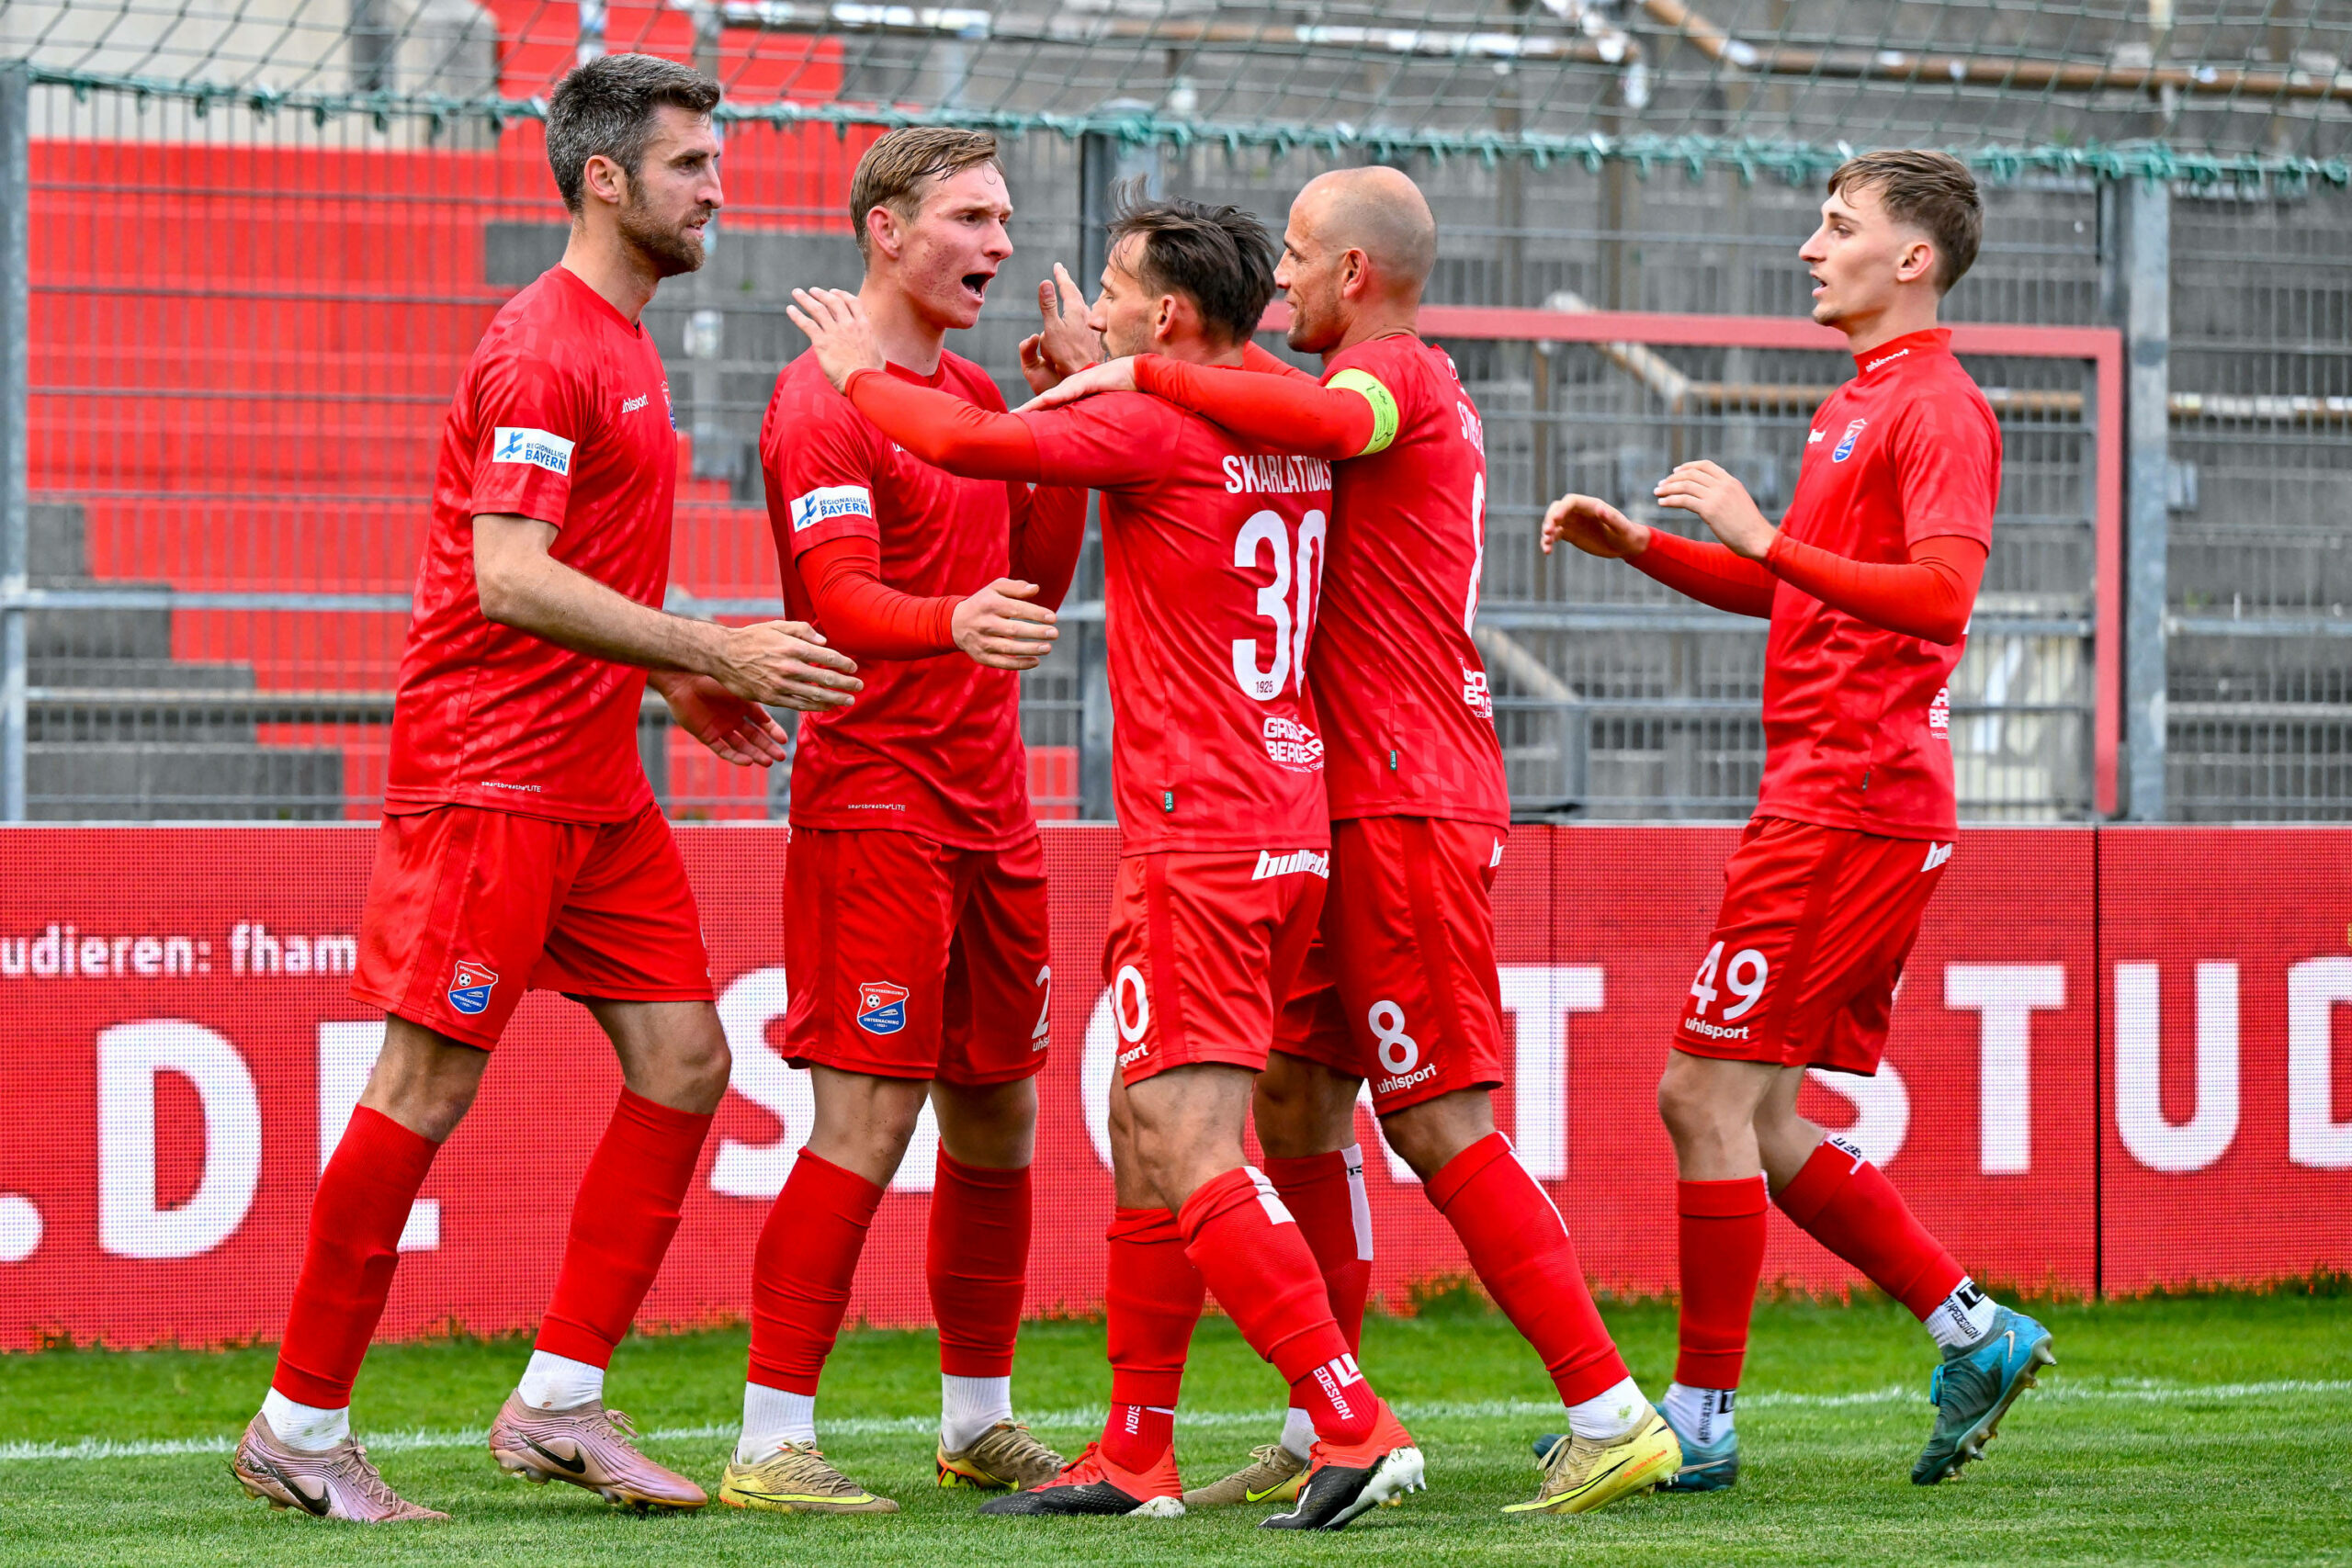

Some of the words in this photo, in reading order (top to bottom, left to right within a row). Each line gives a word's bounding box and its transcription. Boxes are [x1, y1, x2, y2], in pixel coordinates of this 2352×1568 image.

[525, 449, 567, 472] BAYERN
[526, 442, 568, 459] REGIONALLIGA
[1222, 455, 1332, 494] SKARLATIDIS
[820, 497, 867, 506] REGIONALLIGA
[820, 502, 869, 516] BAYERN
[1232, 509, 1327, 702] 30
[1255, 680, 1273, 694] 1925
[1690, 941, 1770, 1021] 49
[1368, 999, 1419, 1075] 8
[1684, 1017, 1750, 1040] uhlsport
[1377, 1062, 1438, 1094] uhlsport
